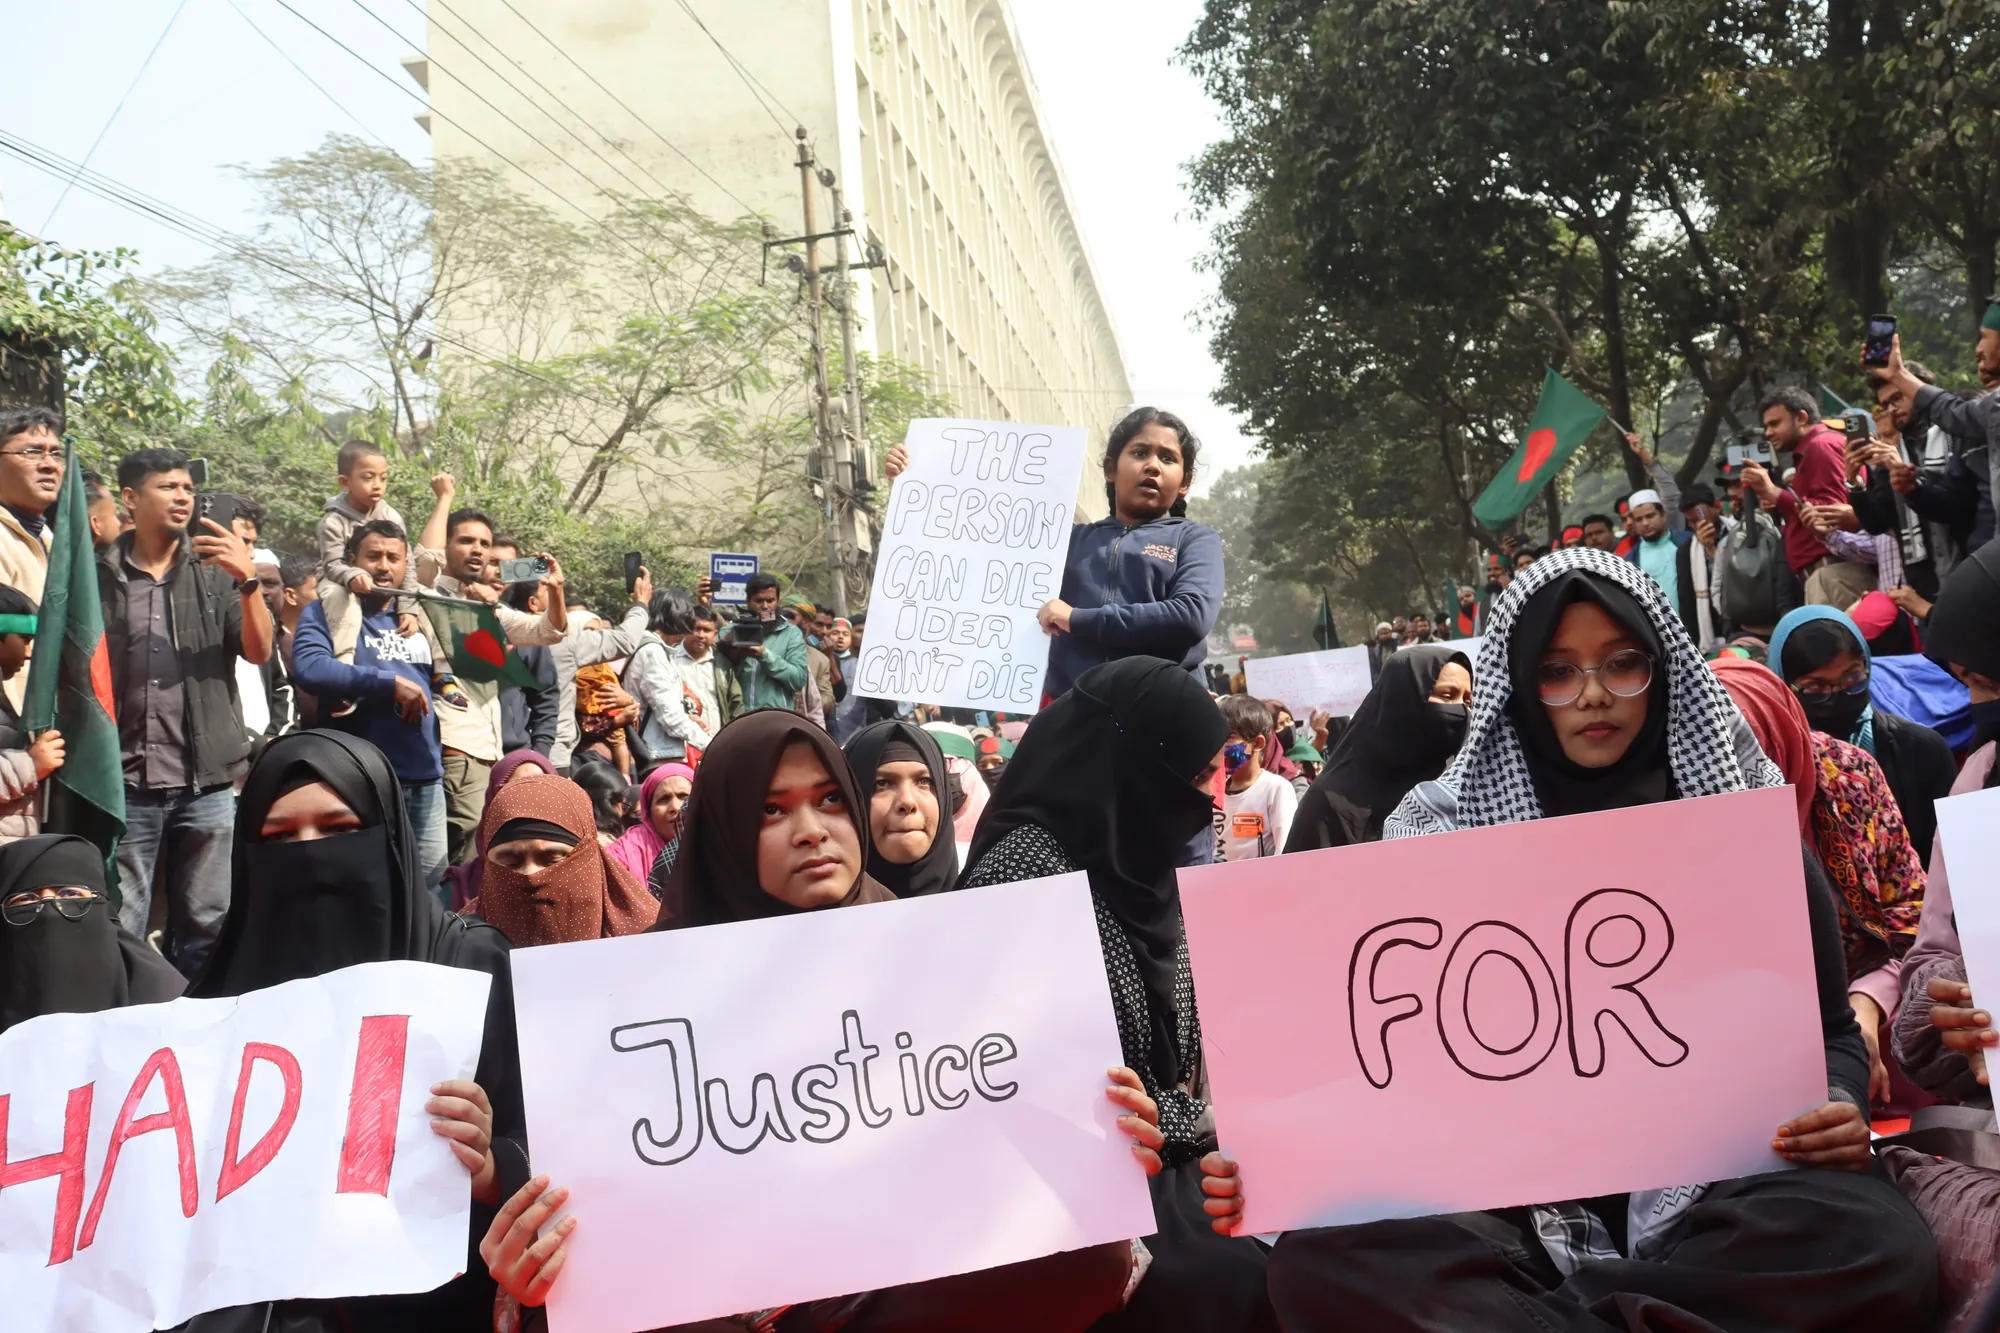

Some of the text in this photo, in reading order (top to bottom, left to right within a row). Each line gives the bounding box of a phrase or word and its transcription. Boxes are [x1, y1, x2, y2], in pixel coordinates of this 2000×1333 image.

[941, 428, 1052, 485] THE
[893, 480, 1066, 549] PERSON
[882, 545, 1052, 609] CAN DIE
[1140, 550, 1175, 562] JONES
[858, 645, 964, 694] CAN'T
[1347, 888, 1690, 1090] FOR
[610, 1009, 1019, 1166] Justice
[0, 1014, 413, 1268] HADI
